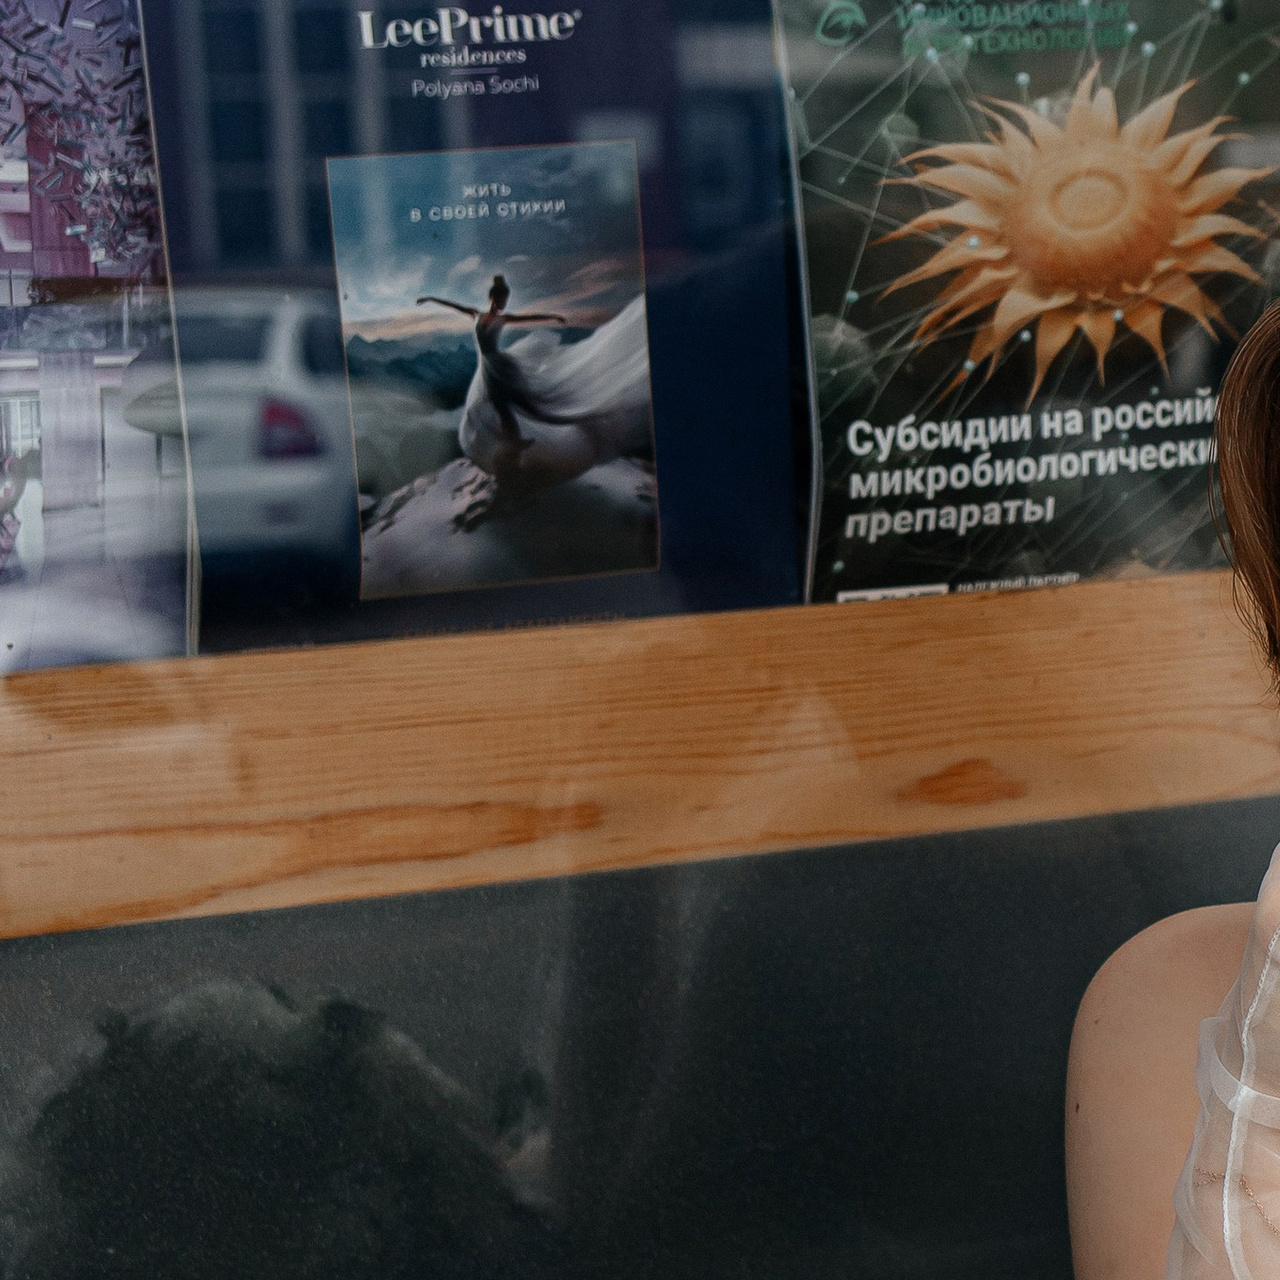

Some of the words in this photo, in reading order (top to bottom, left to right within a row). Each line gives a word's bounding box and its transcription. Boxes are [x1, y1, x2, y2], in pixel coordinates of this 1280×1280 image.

[358, 4, 577, 49] LeePrime
[420, 45, 527, 68] residences
[411, 77, 486, 100] Polyana
[489, 73, 540, 95] Sochi
[463, 182, 512, 199] ЖИТЬ
[409, 207, 422, 223] В
[428, 201, 490, 222] СВОЕЙ
[497, 198, 566, 218] СТИХИИ
[846, 413, 1032, 462] Субсидии
[1040, 407, 1084, 440] на
[1091, 387, 1220, 443] россий
[844, 495, 1056, 544] препараты
